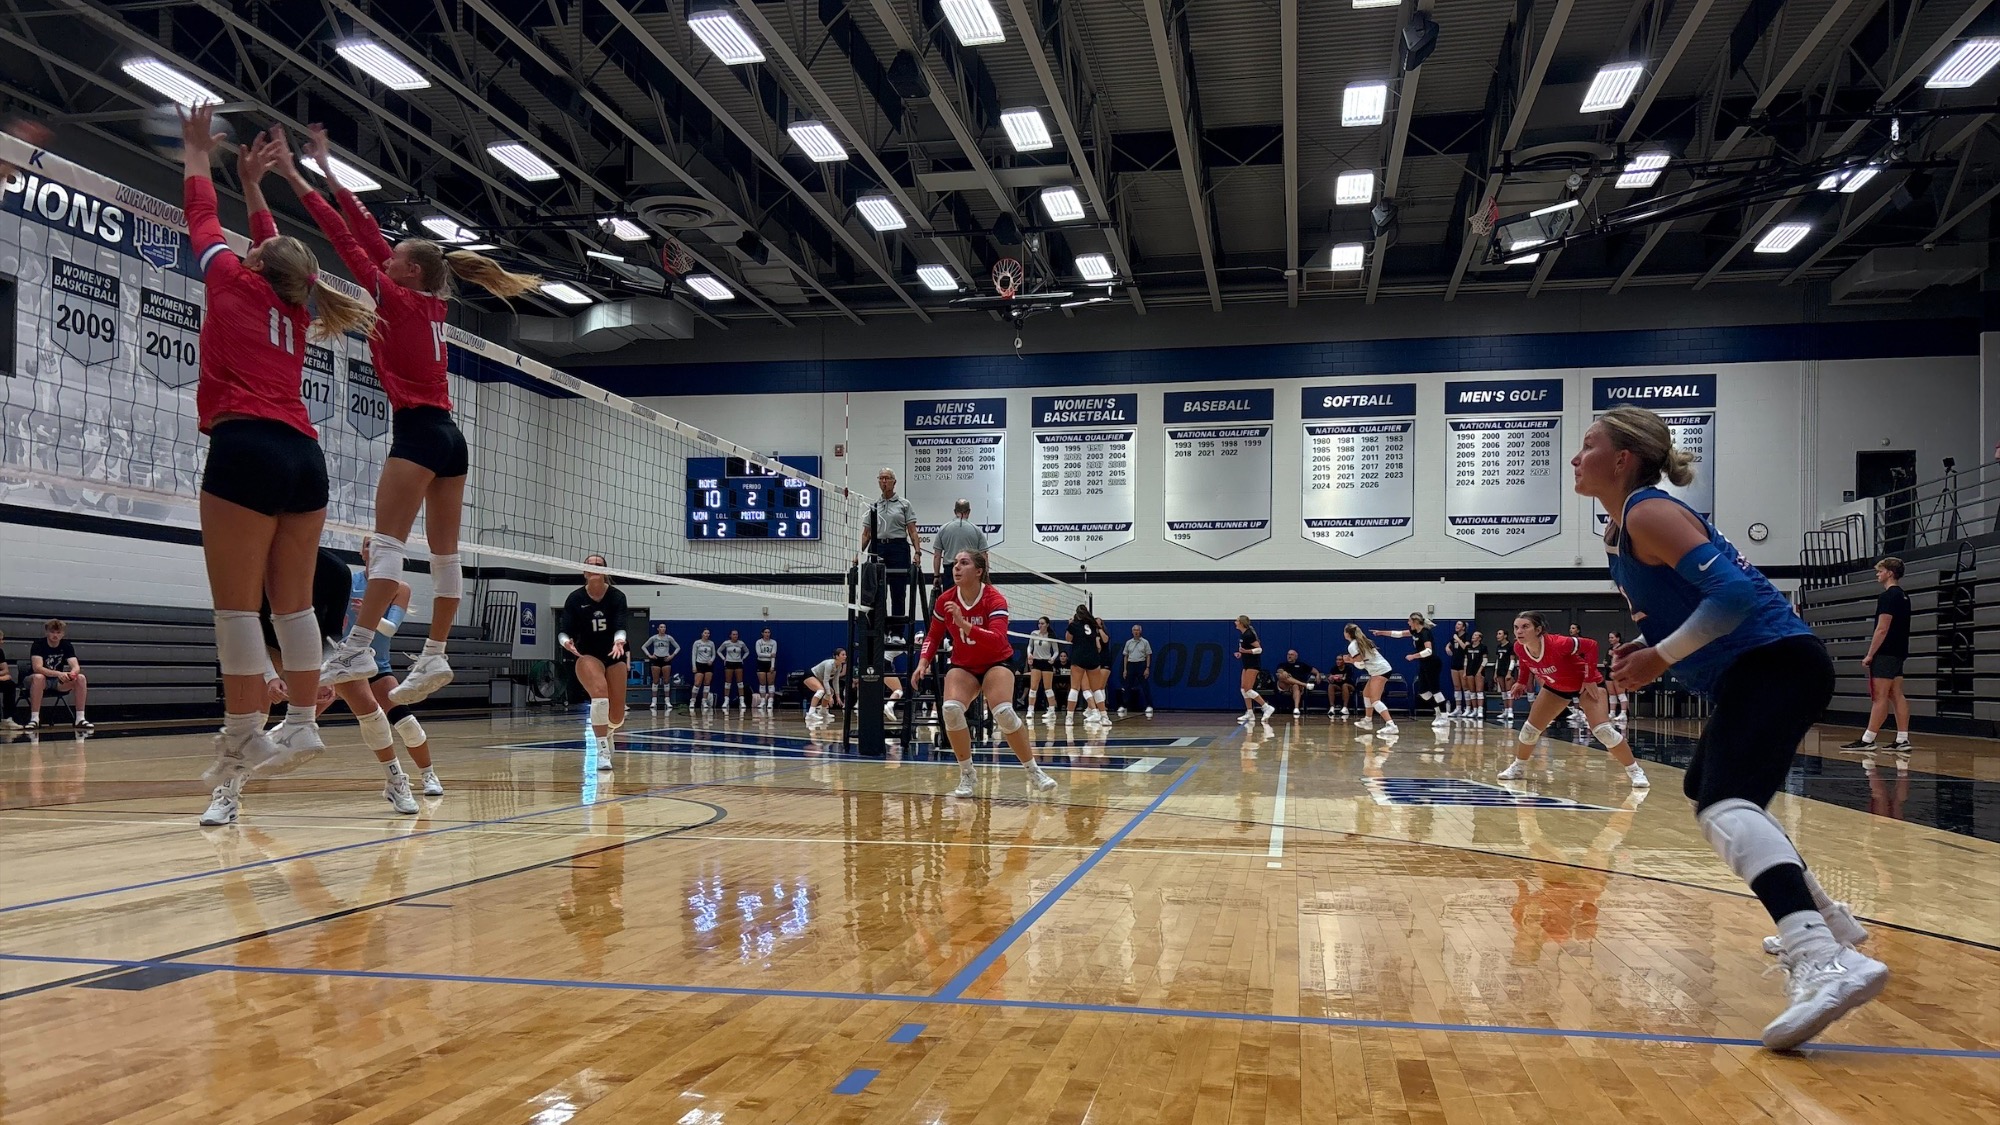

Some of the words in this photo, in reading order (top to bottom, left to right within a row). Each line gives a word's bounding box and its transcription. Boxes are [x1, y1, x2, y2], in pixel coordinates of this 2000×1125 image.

[29, 149, 45, 169] K
[0, 170, 124, 243] PIONS
[62, 264, 111, 288] WOMEN'S
[54, 275, 118, 304] BASKETBALL
[150, 294, 193, 316] WOMEN'S
[57, 304, 114, 343] 2009
[143, 303, 199, 330] BASKETBALL
[269, 306, 294, 355] 11
[446, 326, 486, 351] KIRKWOOD
[146, 331, 195, 366] 2010
[516, 356, 522, 366] K
[604, 393, 609, 402] K
[1460, 390, 1505, 403] MEN'S
[1510, 389, 1547, 401] GOLF
[1607, 385, 1700, 398] VOLLEYBALL
[351, 394, 385, 420] 2019
[936, 403, 975, 413] MEN'S
[1054, 398, 1115, 410] WOMEN'S
[1184, 400, 1251, 412] BASEBALL
[1323, 395, 1393, 407] SOFTBALL
[916, 414, 994, 425] BASKETBALL
[1044, 410, 1125, 422] BASKETBALL
[705, 490, 721, 508] 10
[748, 492, 756, 506] 2
[799, 489, 810, 507] 8
[693, 512, 708, 520] WON
[740, 511, 766, 520] MATCH
[796, 511, 811, 520] WON
[702, 524, 707, 536] 1
[717, 522, 726, 536] 2
[778, 522, 787, 536] 2
[801, 522, 810, 537] 0
[591, 619, 607, 631] 15
